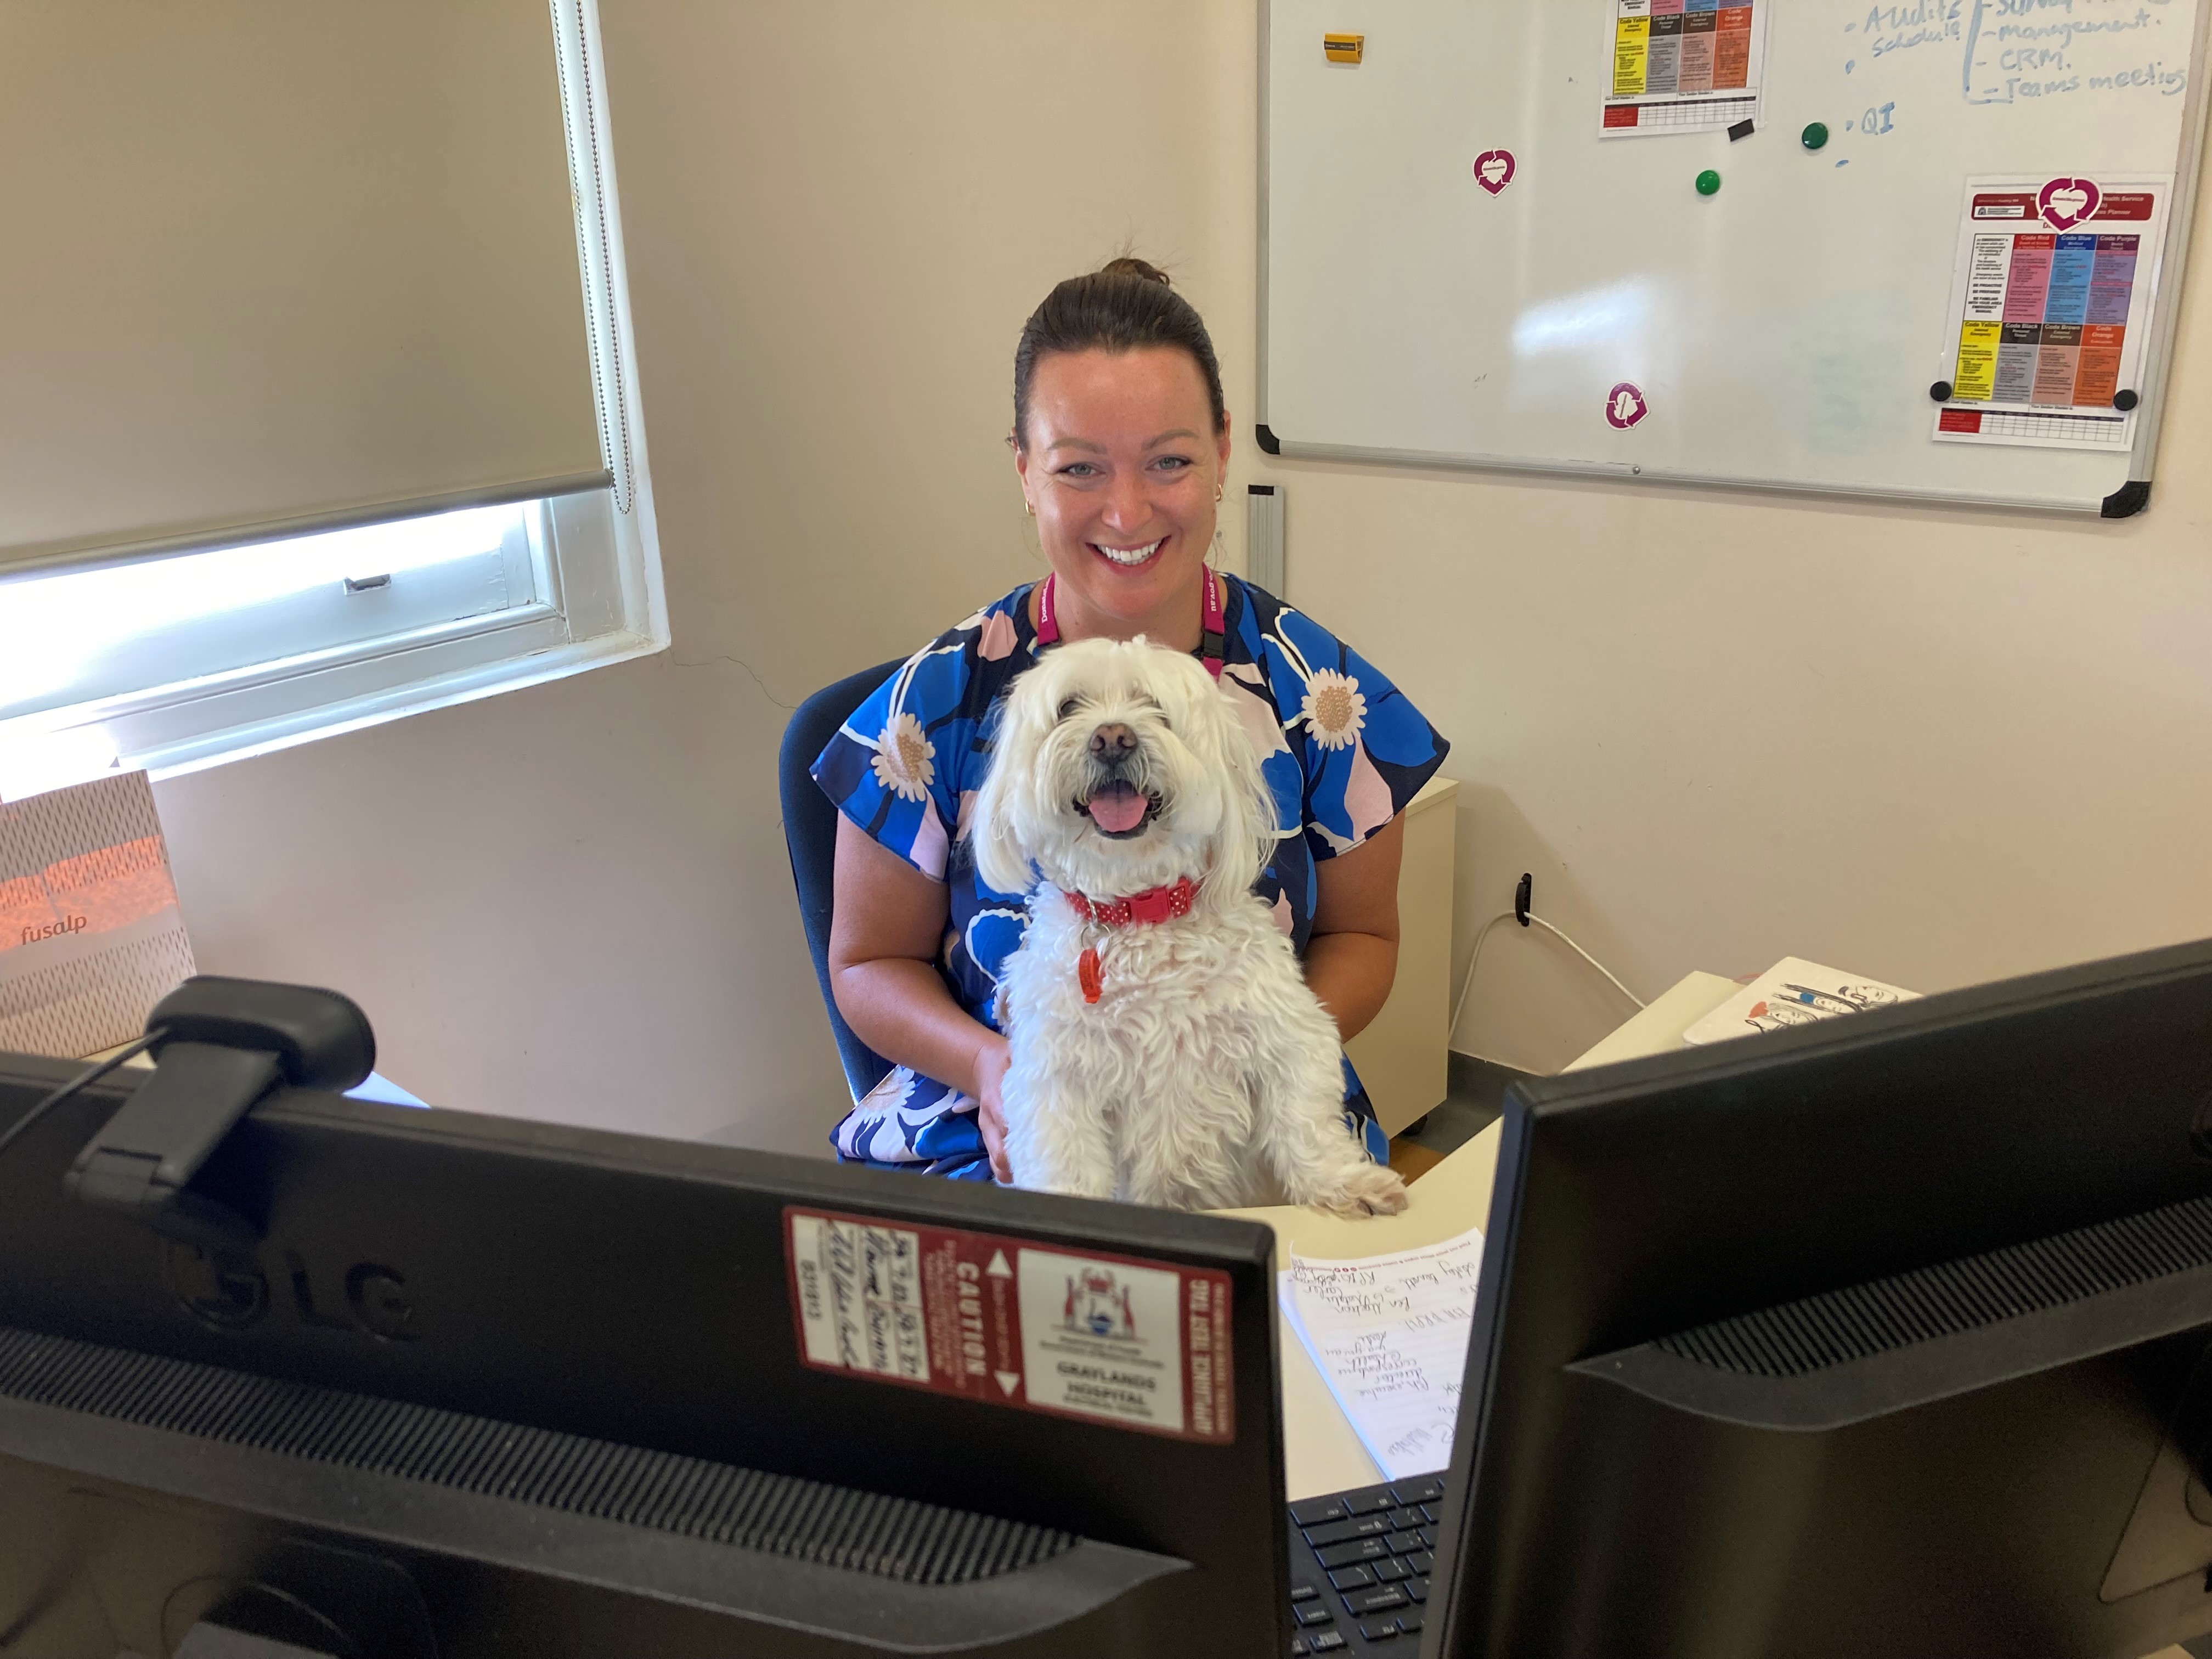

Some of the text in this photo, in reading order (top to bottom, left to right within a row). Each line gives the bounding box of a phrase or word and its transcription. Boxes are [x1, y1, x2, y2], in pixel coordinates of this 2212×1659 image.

[20, 915, 87, 945] fusalp
[956, 1261, 986, 1375] CAUTION
[1057, 1361, 1156, 1392] GRAYLANDS
[1066, 1381, 1145, 1405] HOSPITAL
